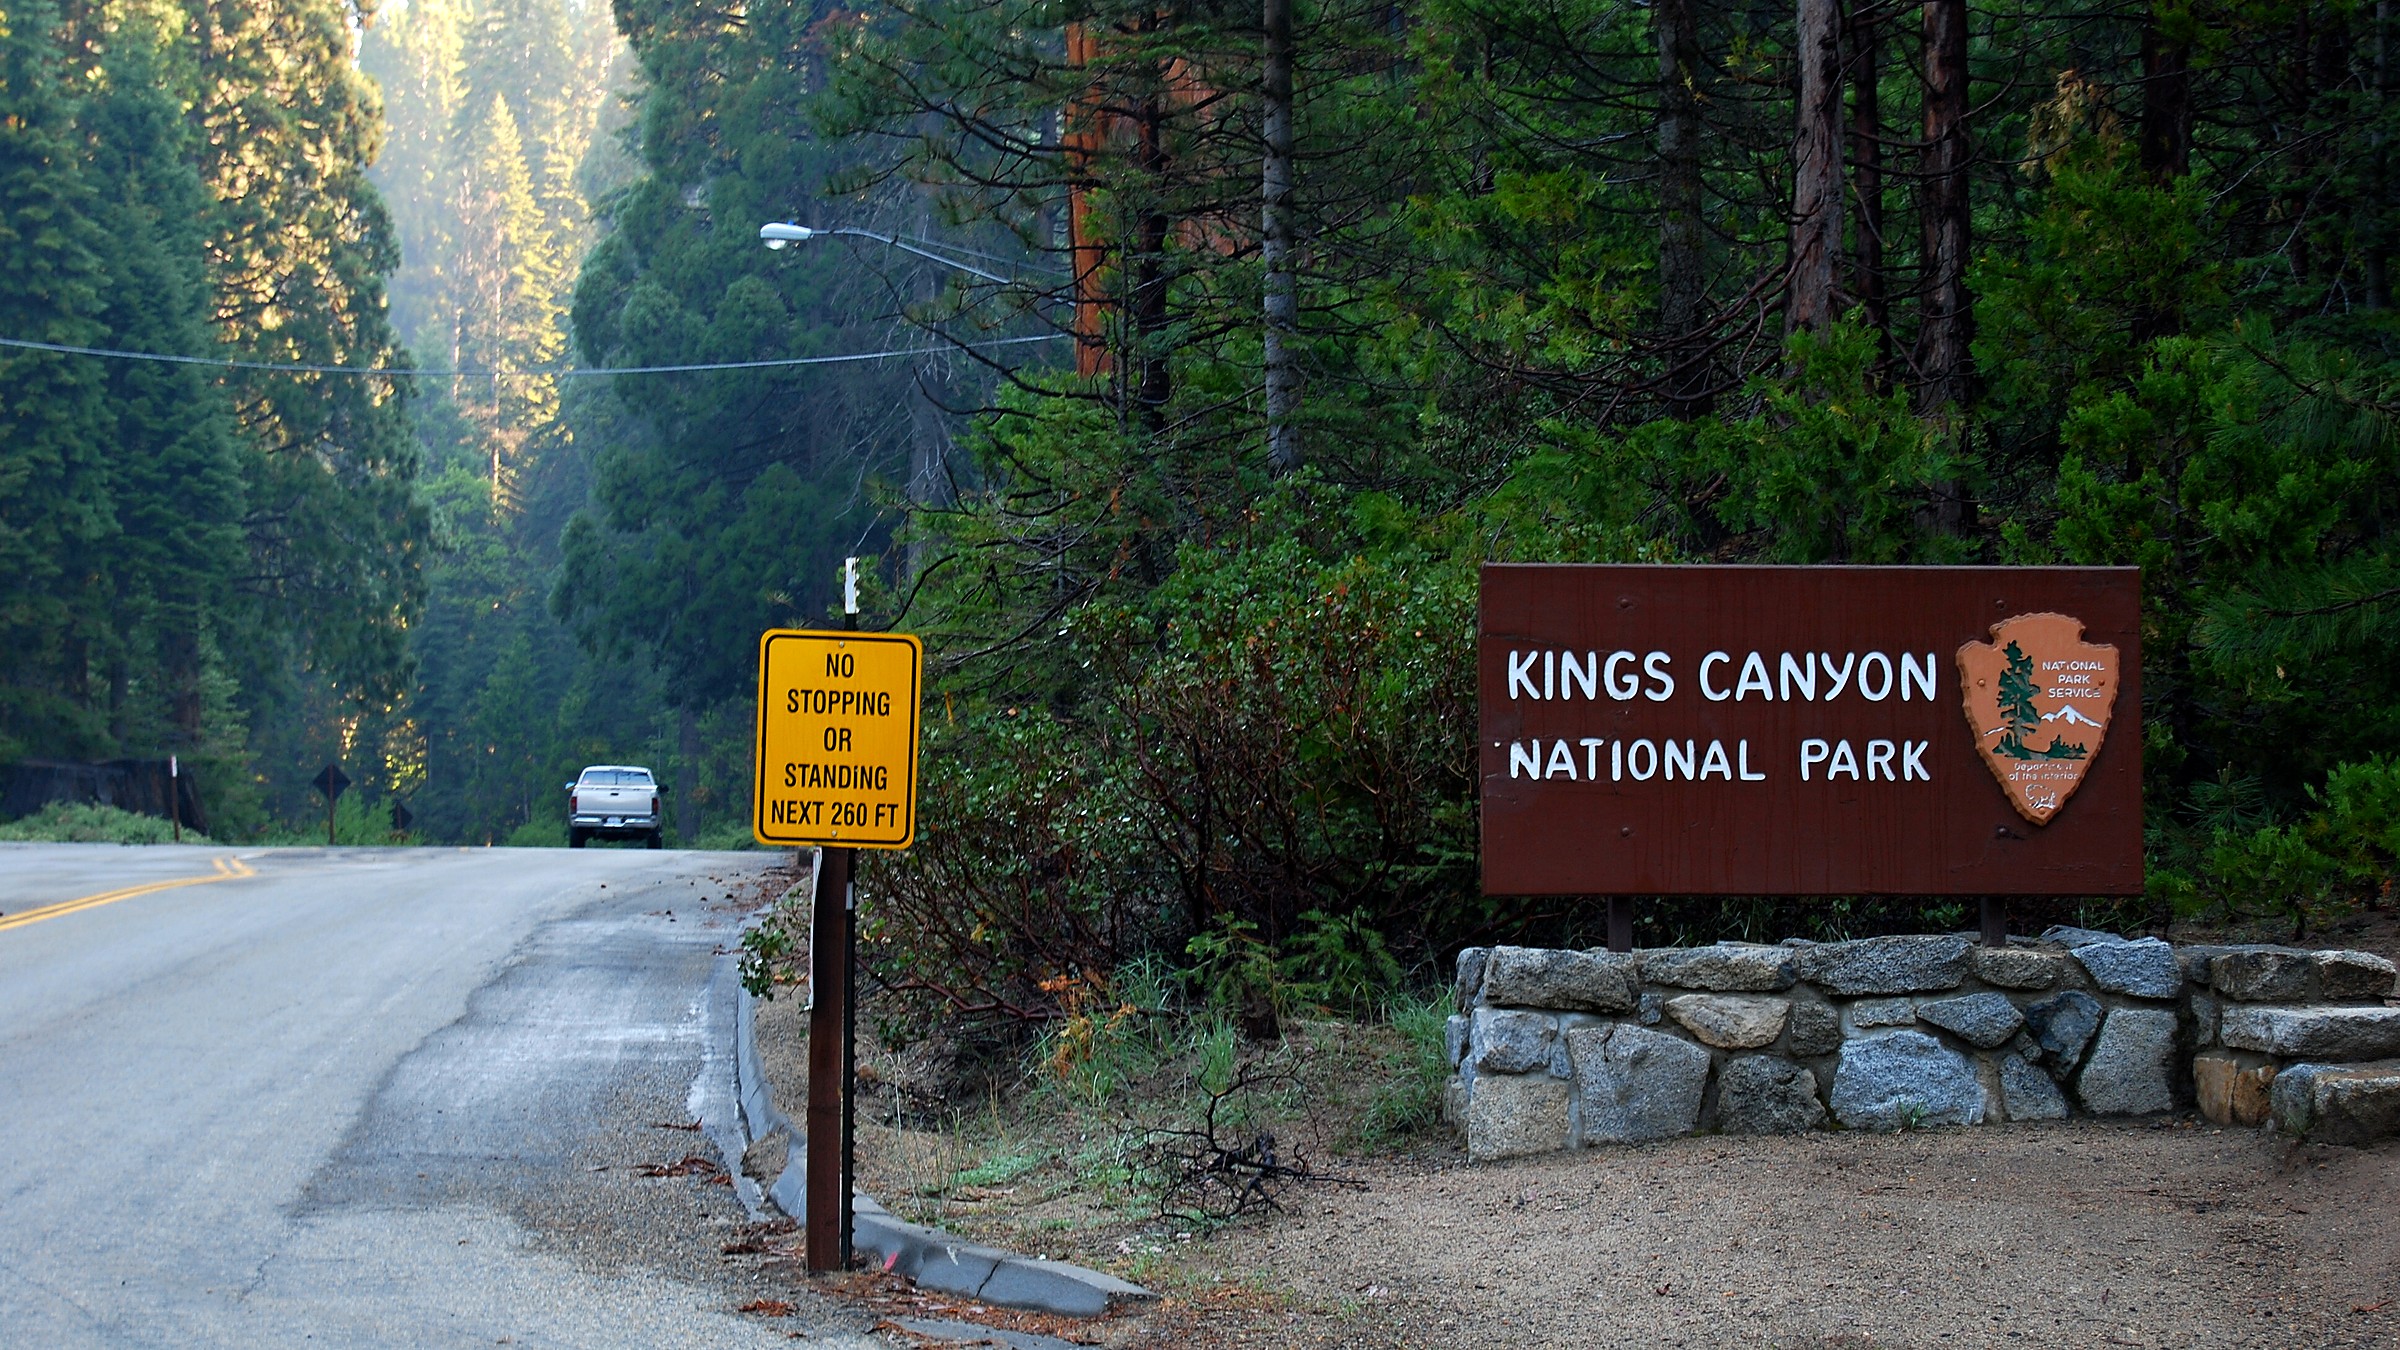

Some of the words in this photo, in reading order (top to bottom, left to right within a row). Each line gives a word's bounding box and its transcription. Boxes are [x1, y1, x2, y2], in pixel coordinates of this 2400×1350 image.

[826, 653, 854, 678] NO
[1507, 650, 1675, 701] KINGS
[1699, 650, 1937, 701] CANYON
[2042, 661, 2105, 671] NATIONAL
[2058, 675, 2091, 684] PARK
[787, 689, 890, 717] STOPPING
[2048, 688, 2101, 698] SERVICE
[824, 727, 852, 752] OR
[1509, 738, 1766, 781] NATIONAL
[1800, 738, 1931, 781] PARK
[784, 763, 887, 790] STANDING
[2009, 772, 2018, 781] of
[771, 800, 824, 825] NEXT
[831, 802, 867, 827] 260
[875, 803, 899, 828] FT
